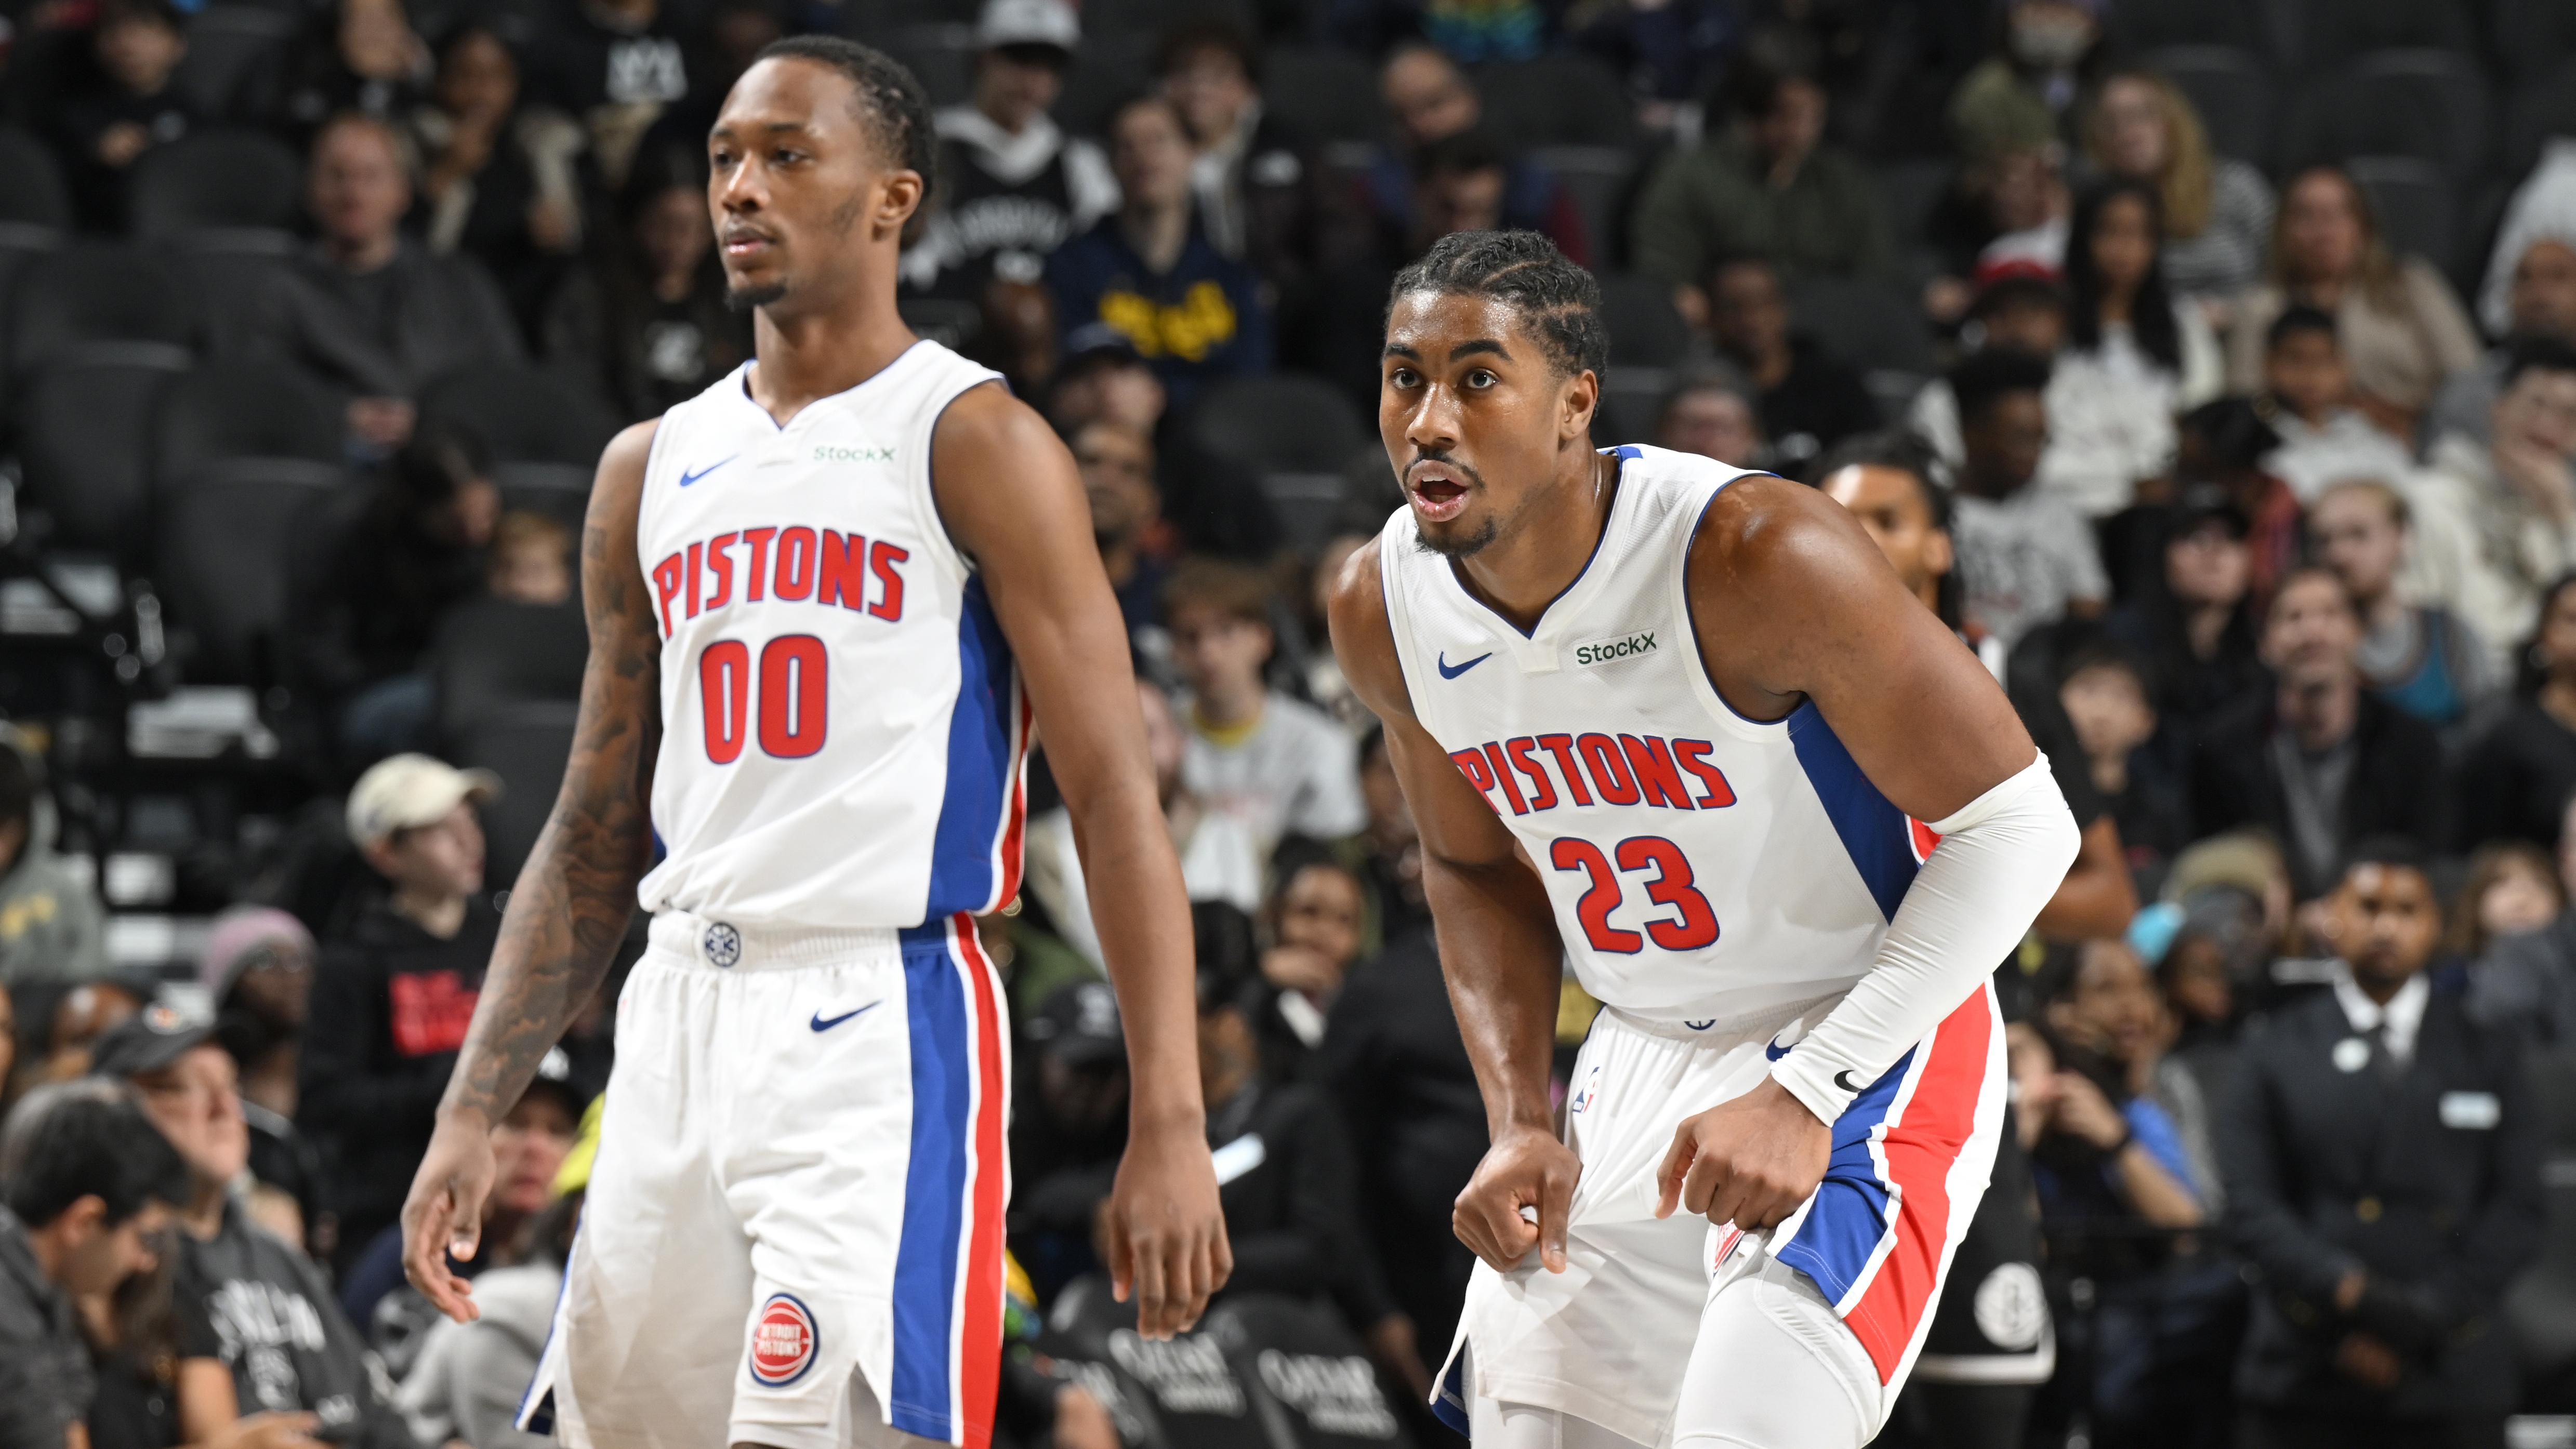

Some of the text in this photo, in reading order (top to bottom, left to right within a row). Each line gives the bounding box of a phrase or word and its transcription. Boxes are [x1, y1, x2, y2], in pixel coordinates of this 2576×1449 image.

[813, 445, 895, 461] StockX
[653, 525, 909, 641] PISTONS
[1577, 631, 1657, 664] StockX
[700, 633, 828, 765] 00
[1449, 732, 1737, 816] PISTONS
[1550, 835, 1720, 955] 23
